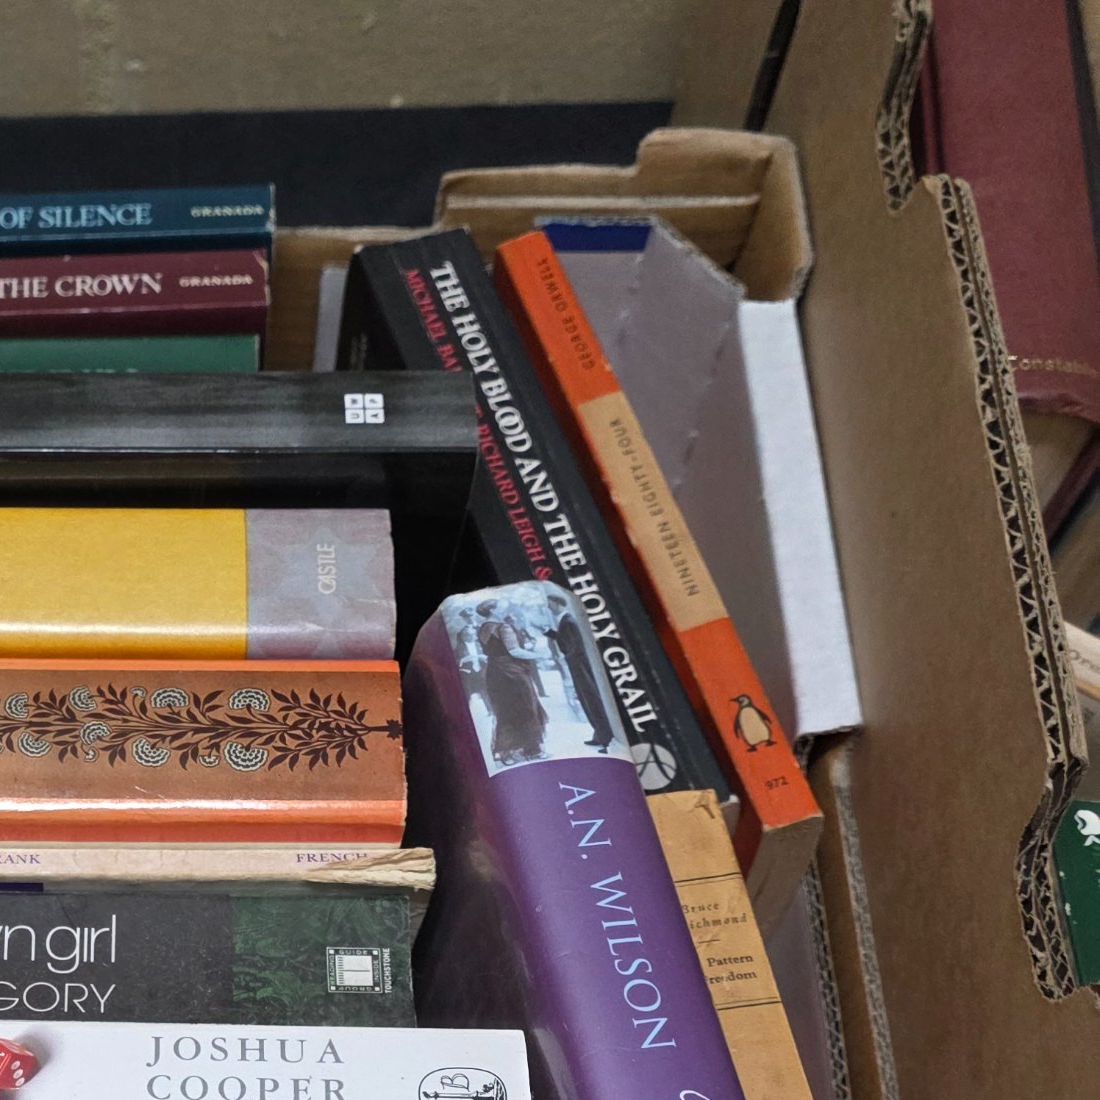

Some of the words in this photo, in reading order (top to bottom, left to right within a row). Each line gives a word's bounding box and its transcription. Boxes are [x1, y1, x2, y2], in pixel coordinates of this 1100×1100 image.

[38, 203, 153, 229] SILENCE
[54, 272, 164, 297] CROWN
[538, 257, 568, 313] ORWELL
[563, 315, 595, 371] GEORGE
[404, 267, 448, 344] MICHAEL
[508, 506, 546, 563] LEIGH
[430, 260, 471, 313] THE
[451, 311, 501, 376] HOLY
[480, 376, 533, 453] BLOOD
[514, 457, 560, 513] AND
[543, 513, 588, 571] THE
[568, 572, 622, 642] HOLY
[602, 646, 659, 733] GRAIL
[316, 542, 337, 595] CASTLE
[659, 521, 701, 597] NINETEEN
[764, 776, 790, 790] 972
[46, 914, 117, 974] girl
[689, 912, 748, 930] ichmond
[382, 947, 393, 994] TOUCHSTONE
[589, 871, 678, 1050] WILSON
[706, 955, 754, 968] Pattern
[146, 1034, 346, 1069] JOSHUA
